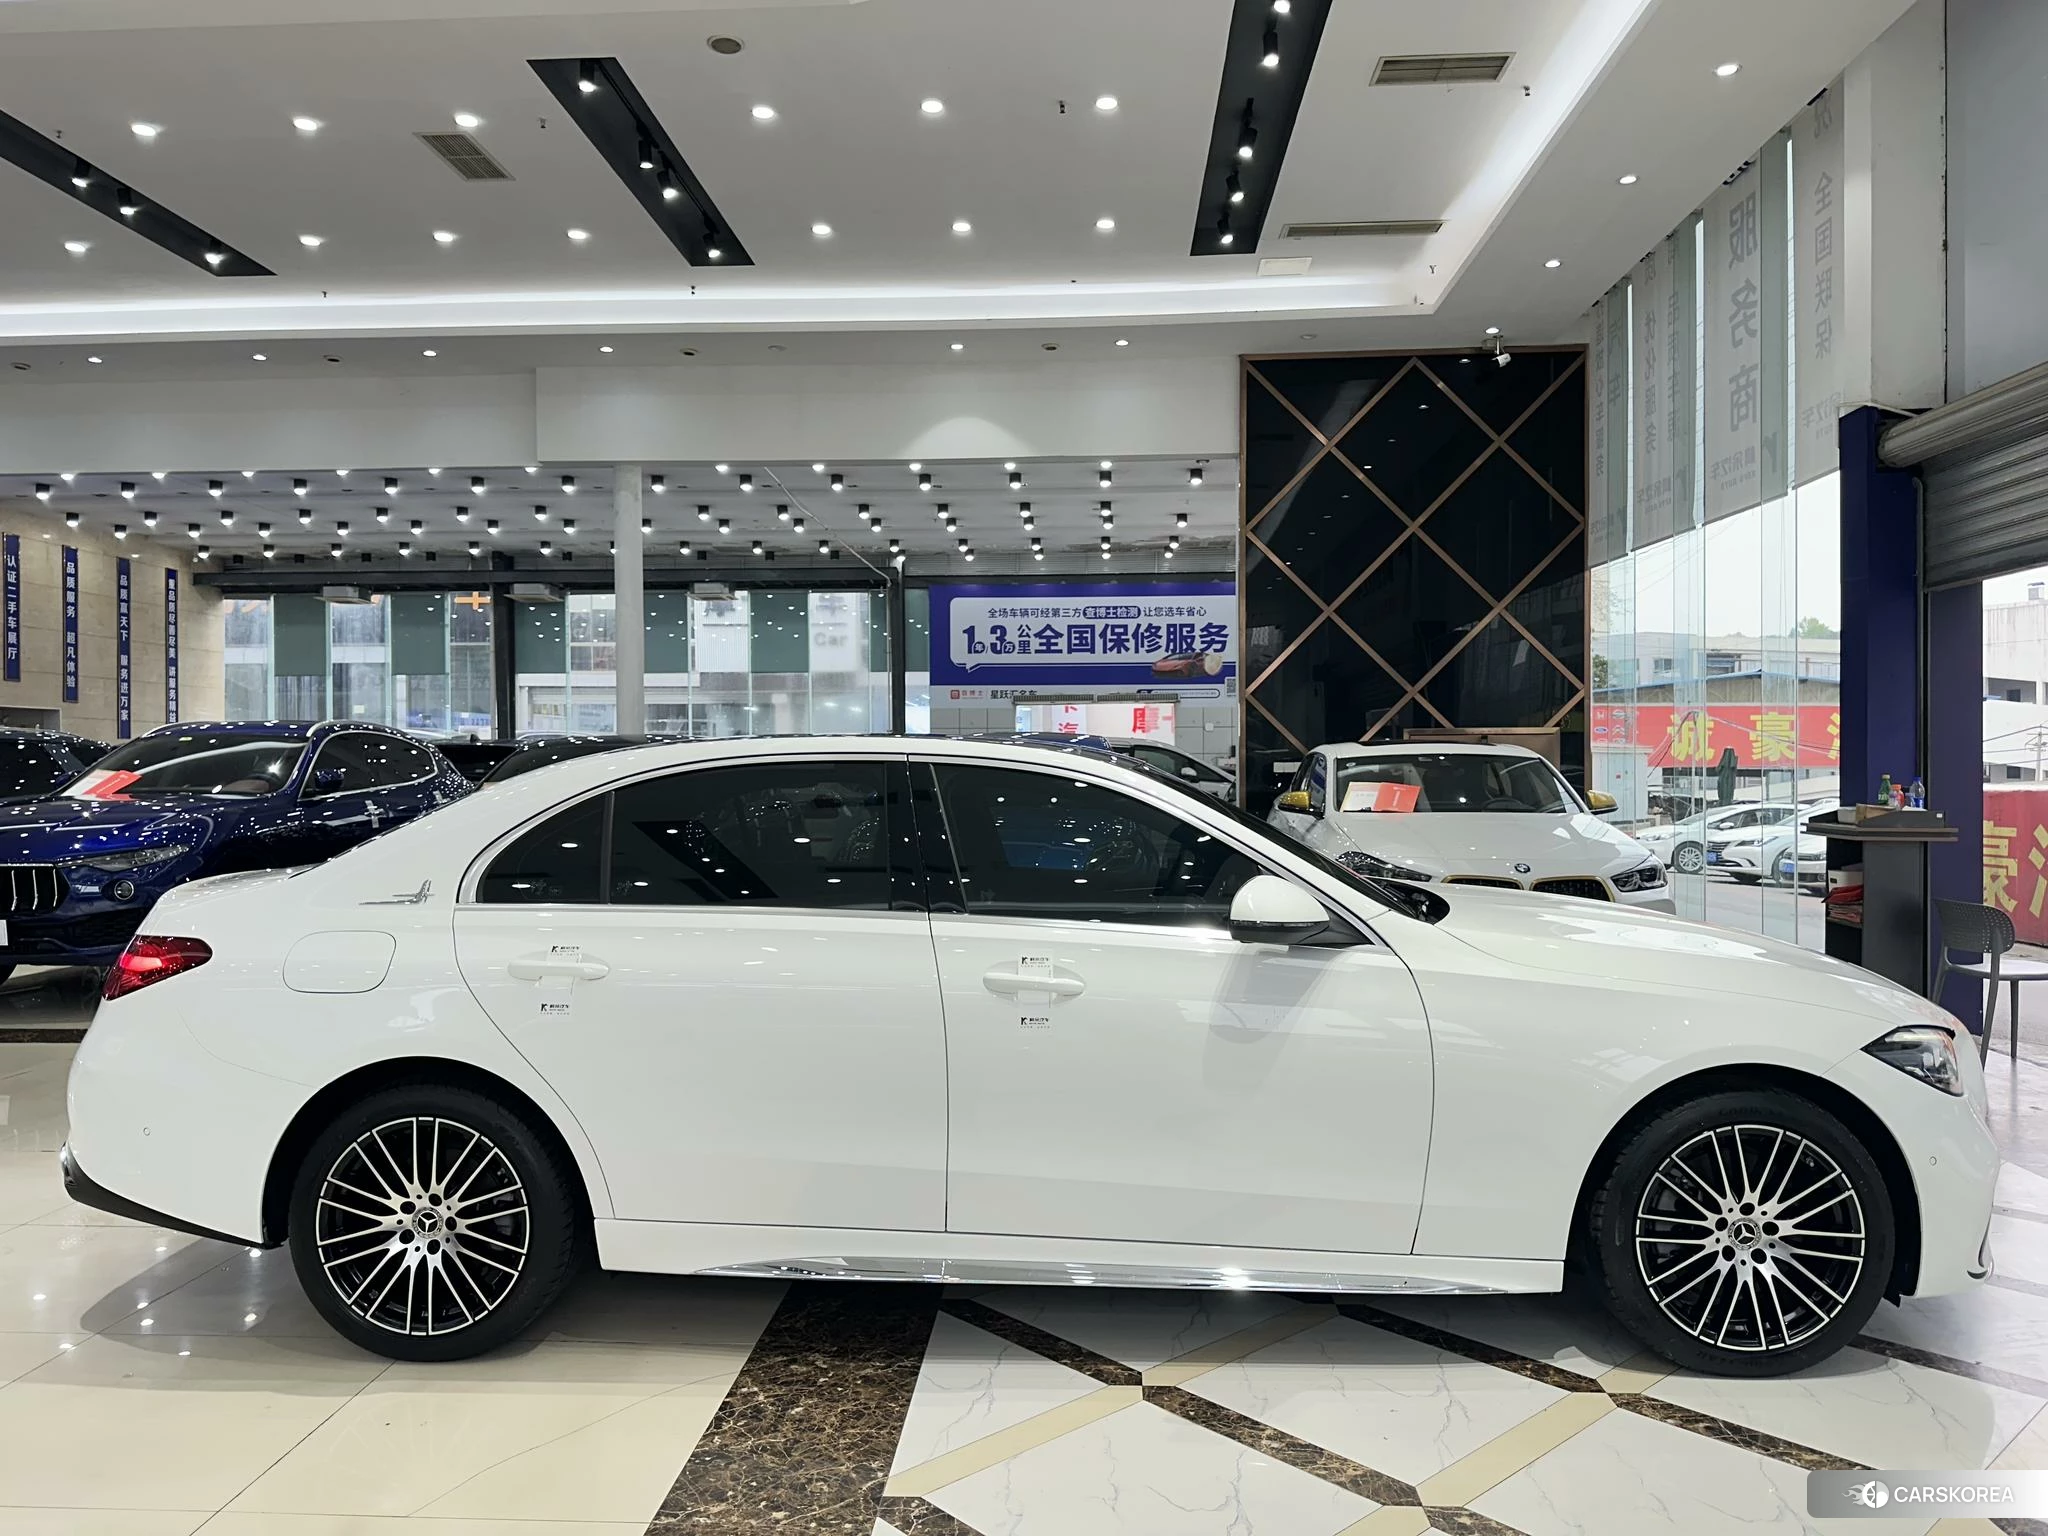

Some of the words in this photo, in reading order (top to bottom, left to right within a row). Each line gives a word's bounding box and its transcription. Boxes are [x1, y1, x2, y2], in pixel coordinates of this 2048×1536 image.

[7, 555, 17, 660] 认证二手车展厅
[66, 562, 75, 618] 品质服务
[120, 575, 128, 641] 品质赢天下
[988, 607, 1081, 618] 全场车辆可经第三方
[1143, 606, 1207, 617] 让您选车省心
[66, 631, 75, 688] 超凡体验
[120, 654, 129, 721] 服务进万家
